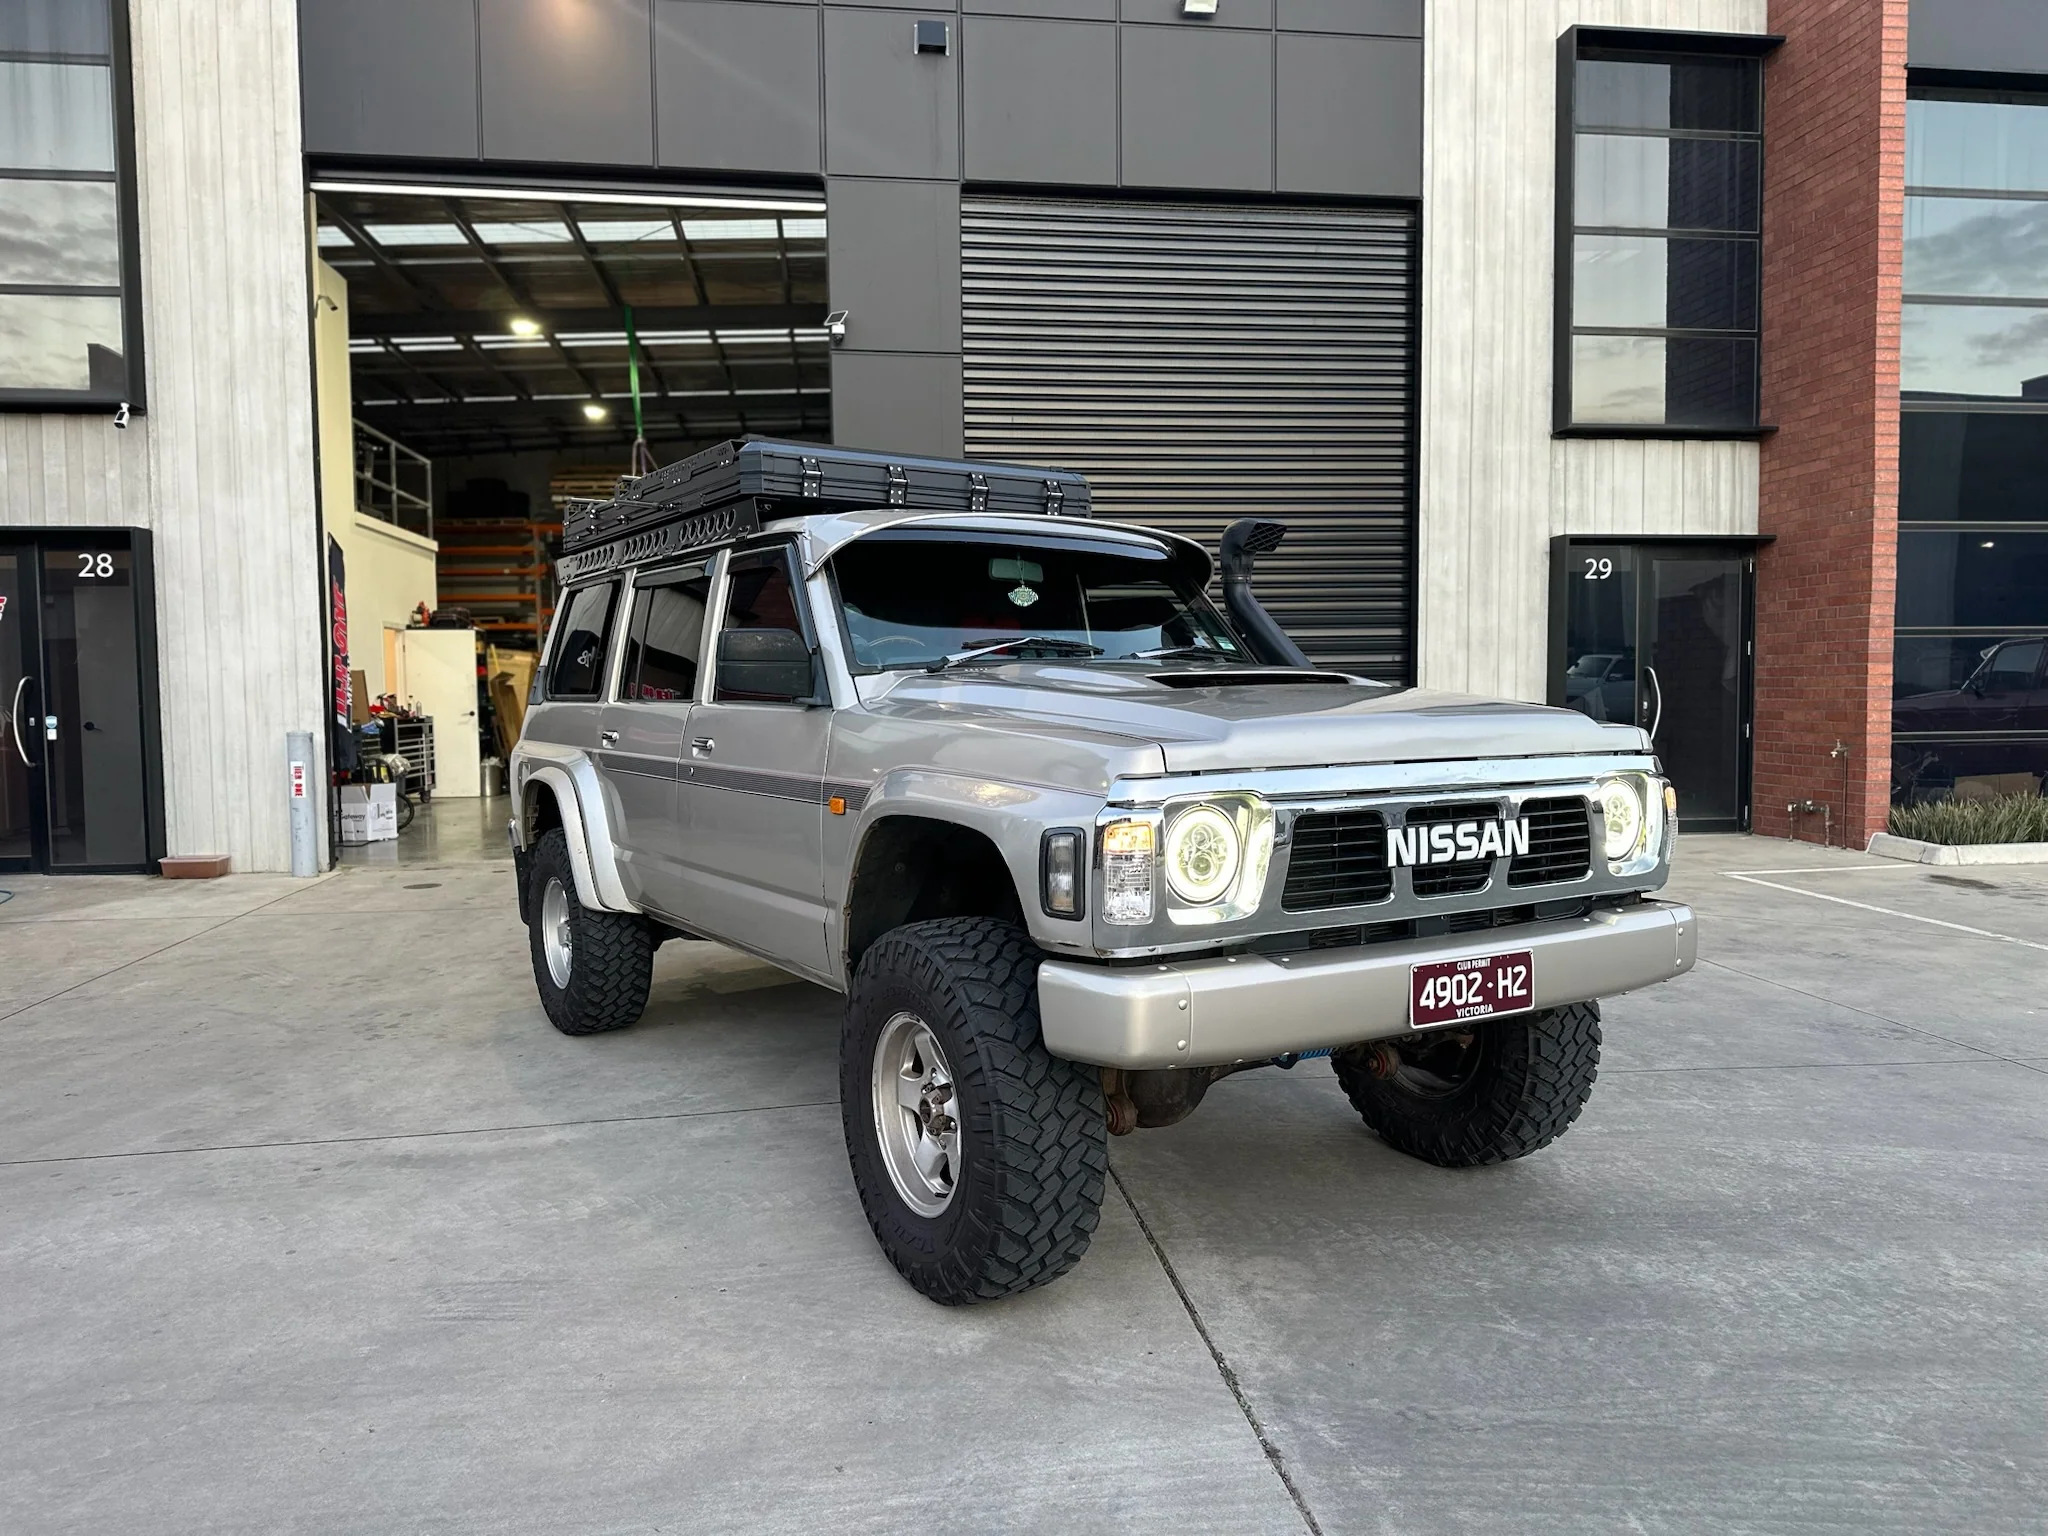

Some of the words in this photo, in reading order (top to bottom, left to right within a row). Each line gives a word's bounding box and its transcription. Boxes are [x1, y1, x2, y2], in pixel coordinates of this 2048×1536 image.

[78, 553, 114, 578] 28
[1584, 558, 1613, 580] 29
[1387, 818, 1529, 867] NISSAN
[1456, 960, 1472, 971] CLUB
[1472, 958, 1492, 969] PERMIT
[1456, 1003, 1494, 1018] VICTORIA
